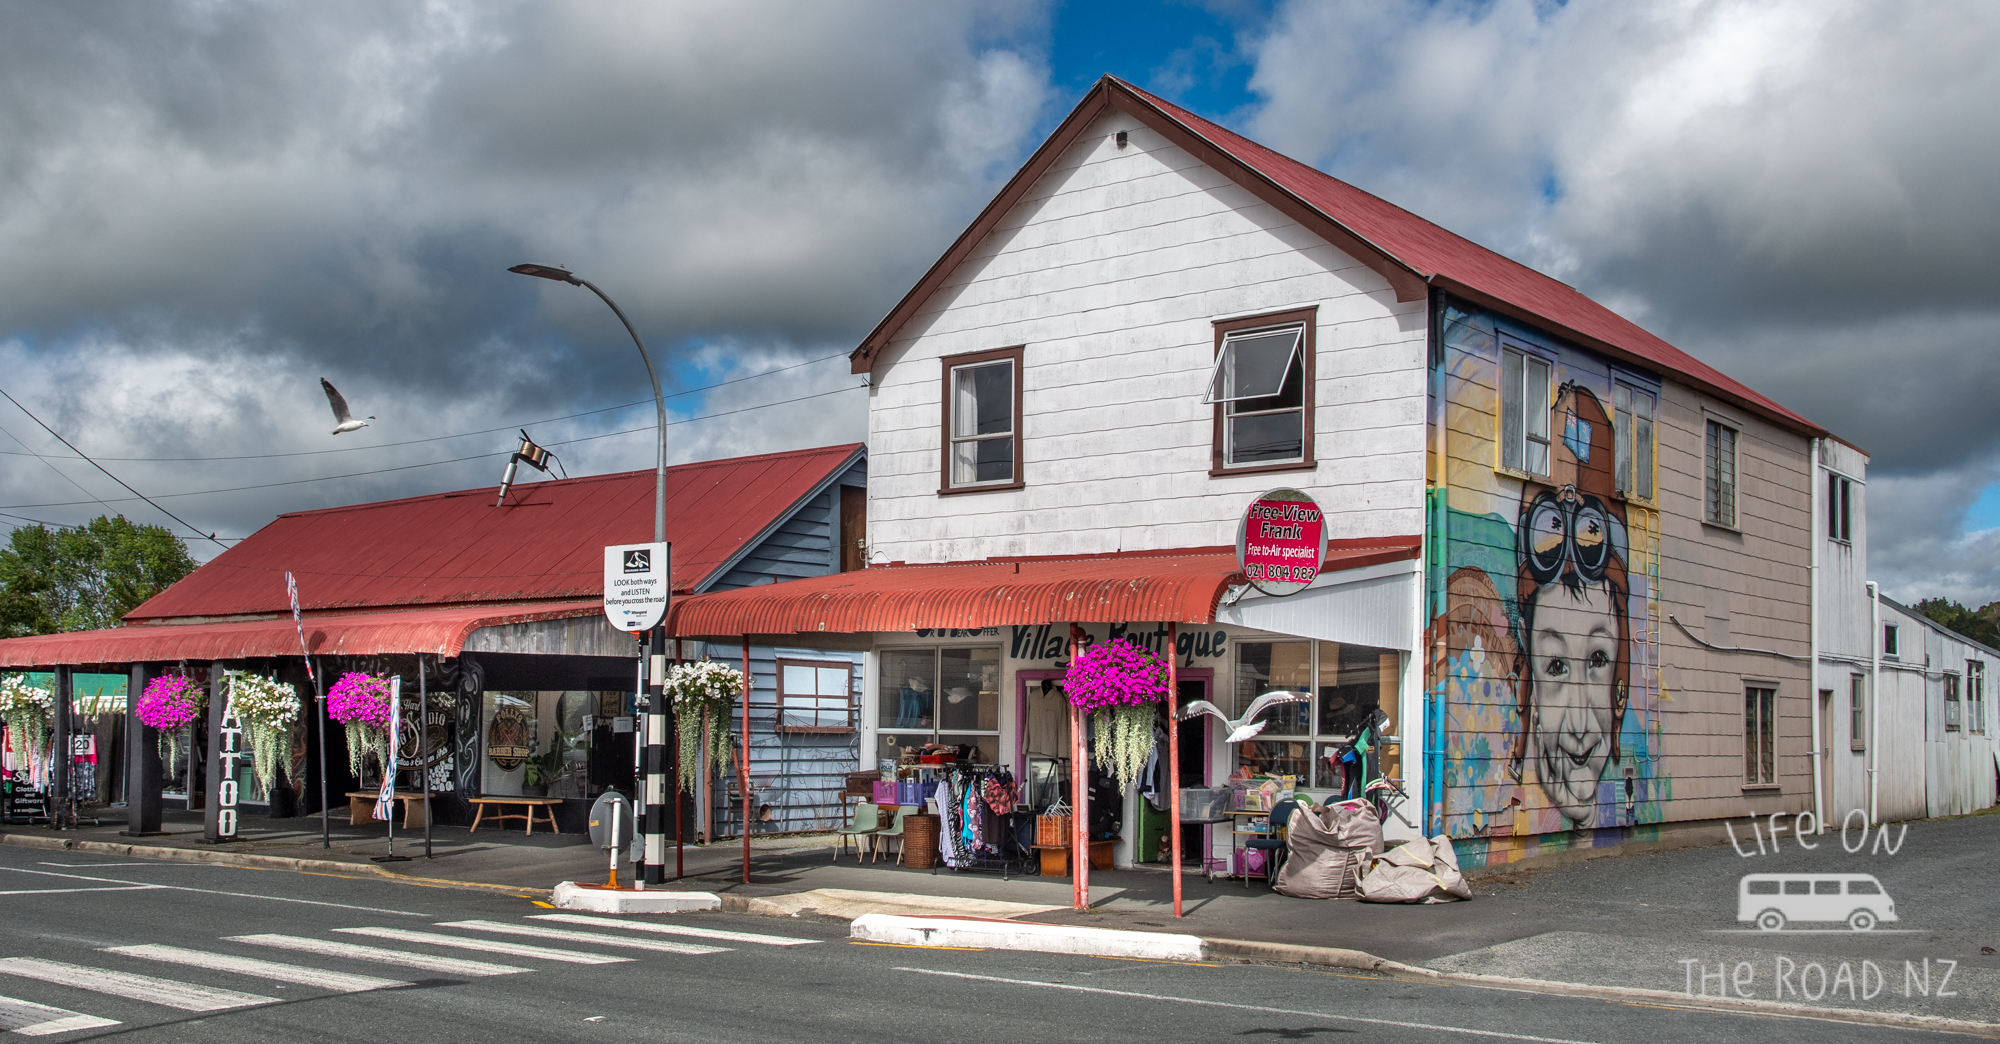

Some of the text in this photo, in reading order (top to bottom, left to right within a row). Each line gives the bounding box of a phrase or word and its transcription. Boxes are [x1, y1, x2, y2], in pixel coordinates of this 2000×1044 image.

[1250, 503, 1320, 522] Free-View
[1260, 522, 1303, 540] Frank
[1248, 543, 1261, 556] Free
[1282, 547, 1314, 560] specialist
[1247, 564, 1265, 578] 021
[1268, 565, 1290, 578] 804
[643, 578, 657, 587] ways
[622, 598, 631, 606] you
[654, 595, 665, 603] road
[488, 747, 529, 757] BARBER SHOP
